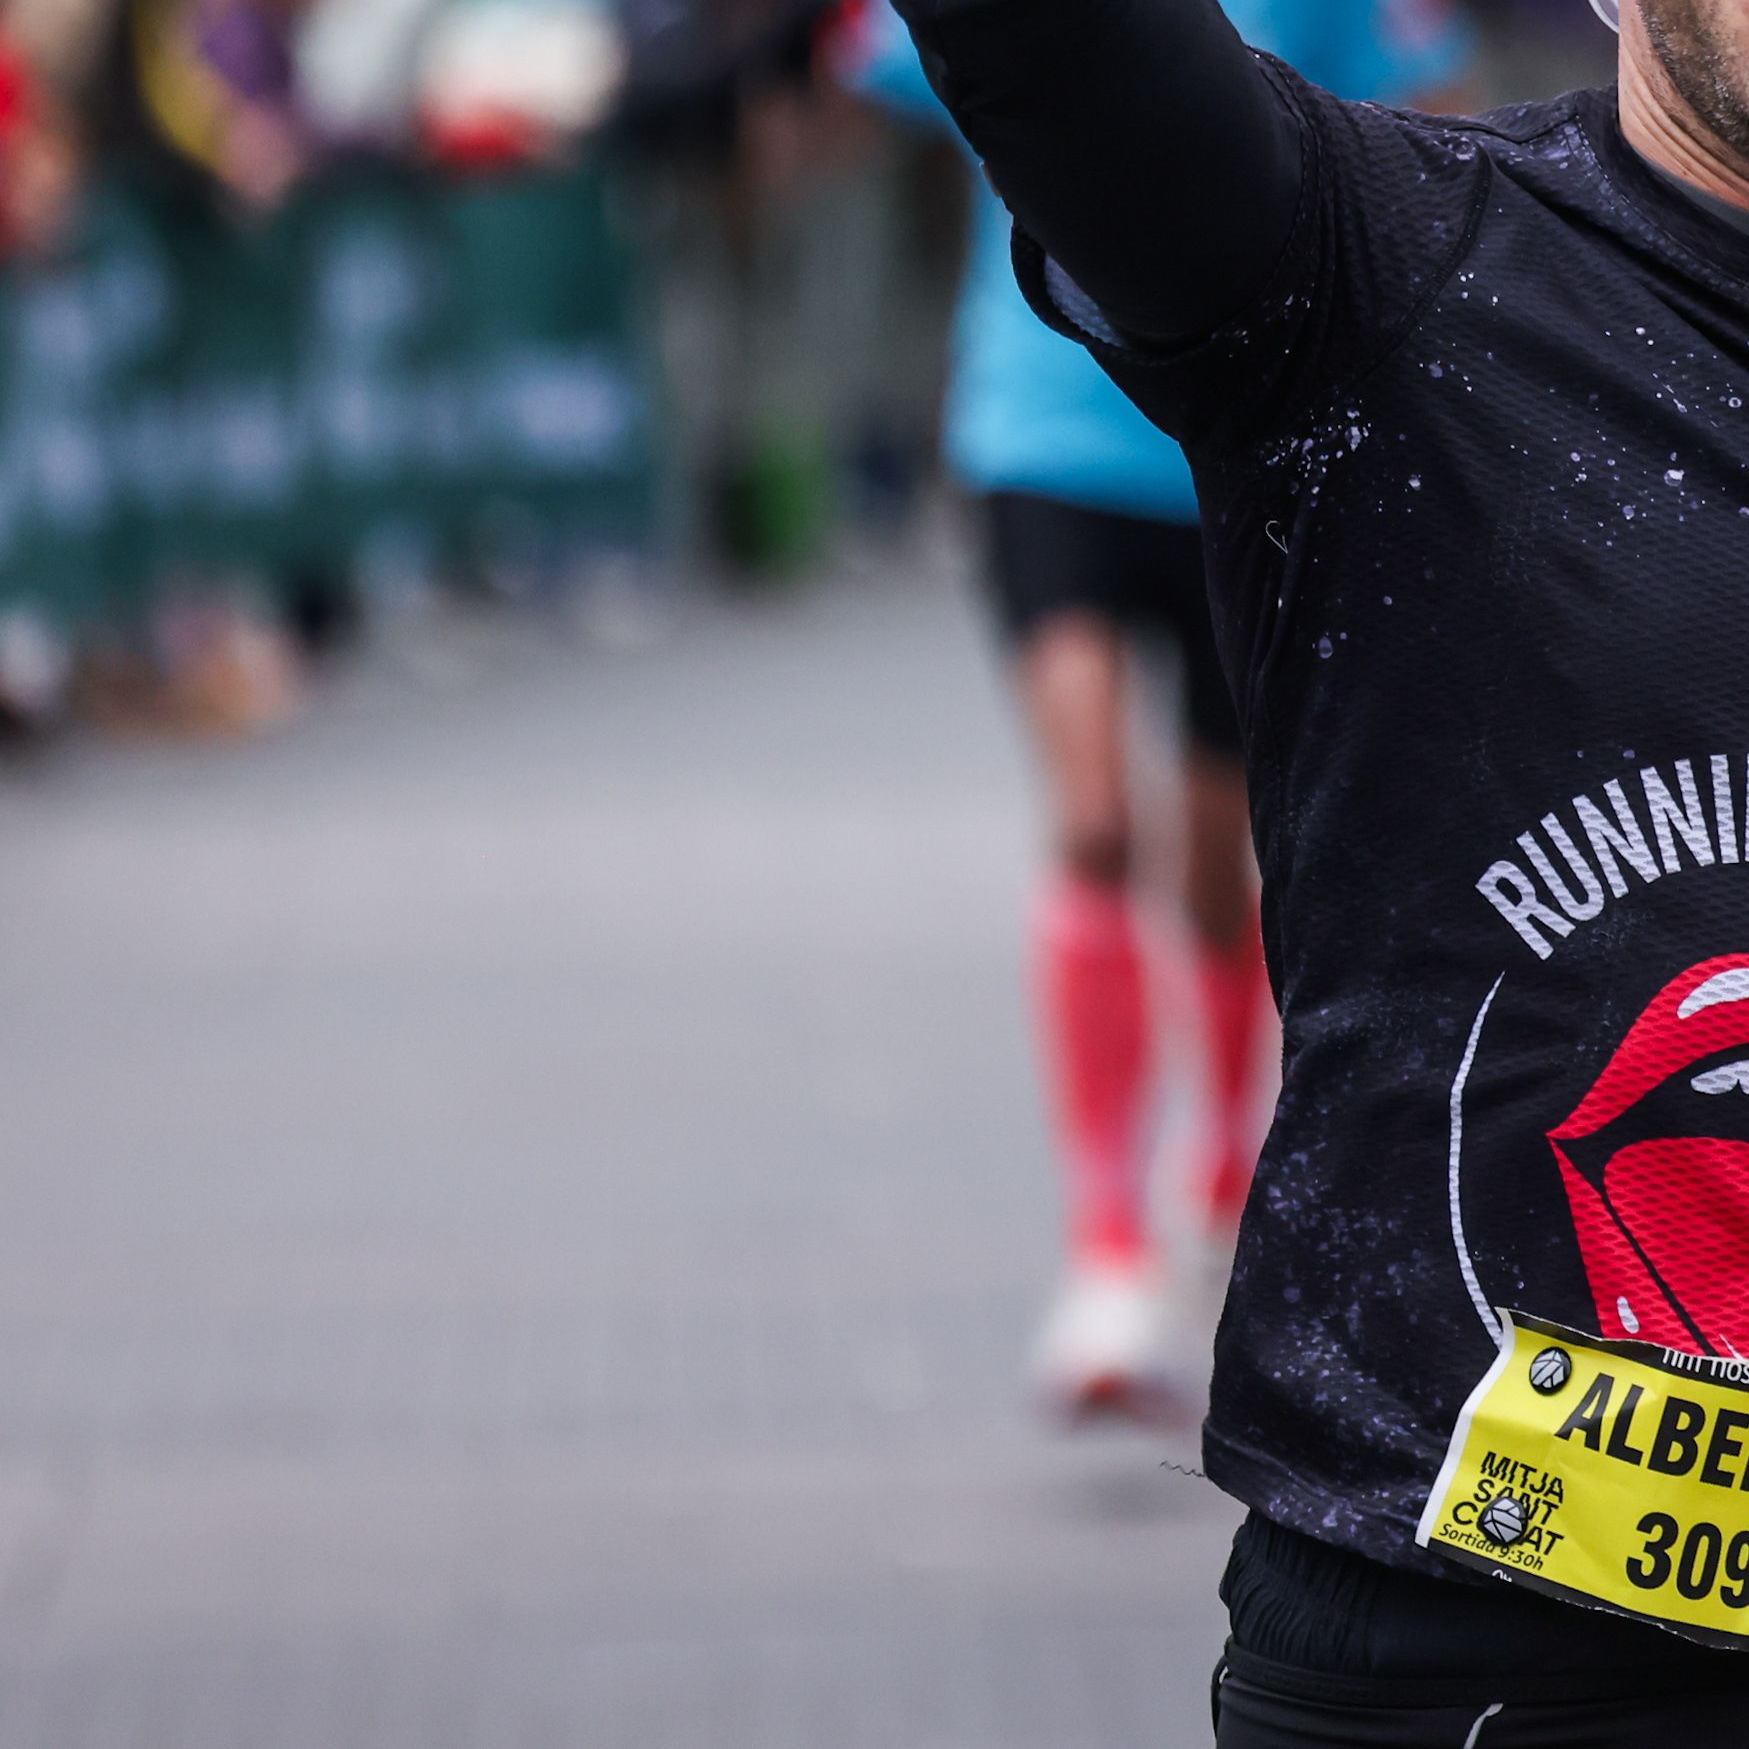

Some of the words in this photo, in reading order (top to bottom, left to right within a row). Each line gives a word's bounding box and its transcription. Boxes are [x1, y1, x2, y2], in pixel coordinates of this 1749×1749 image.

[1480, 1451, 1564, 1504] MITJA
[1452, 1501, 1565, 1556] CAT
[1497, 1545, 1545, 1571] 9:30h
